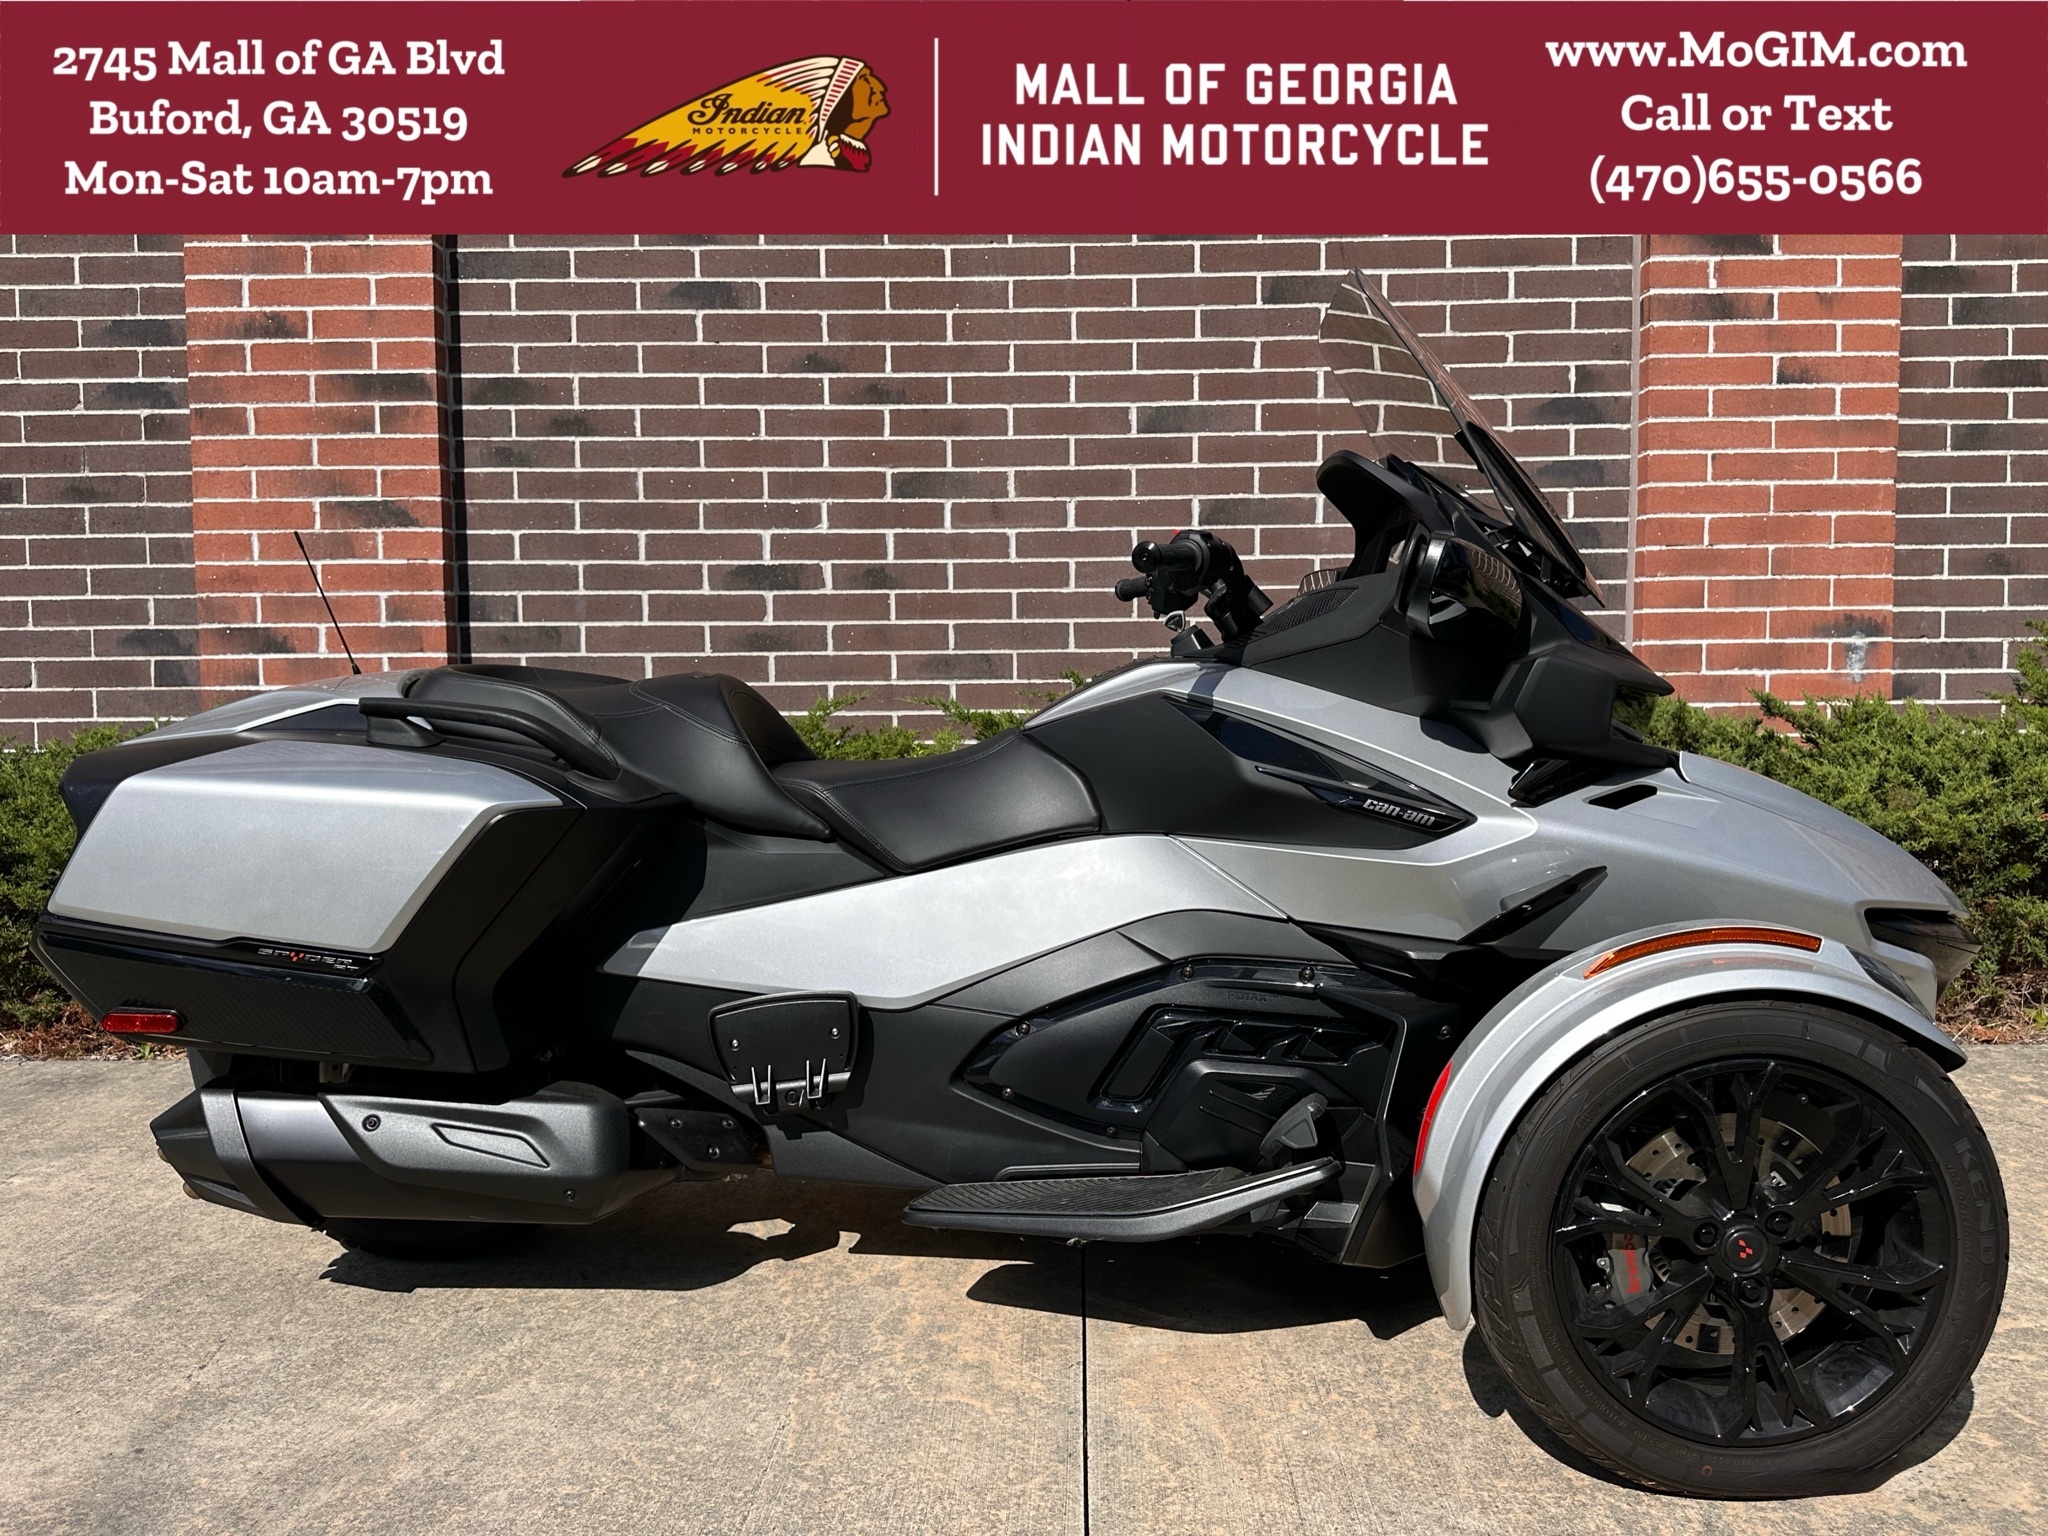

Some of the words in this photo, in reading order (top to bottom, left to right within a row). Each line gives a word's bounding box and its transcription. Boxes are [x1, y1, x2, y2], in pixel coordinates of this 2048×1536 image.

[1362, 798, 1436, 827] can-am
[257, 948, 354, 966] SPYDER
[1954, 1138, 1996, 1303] KENDA
